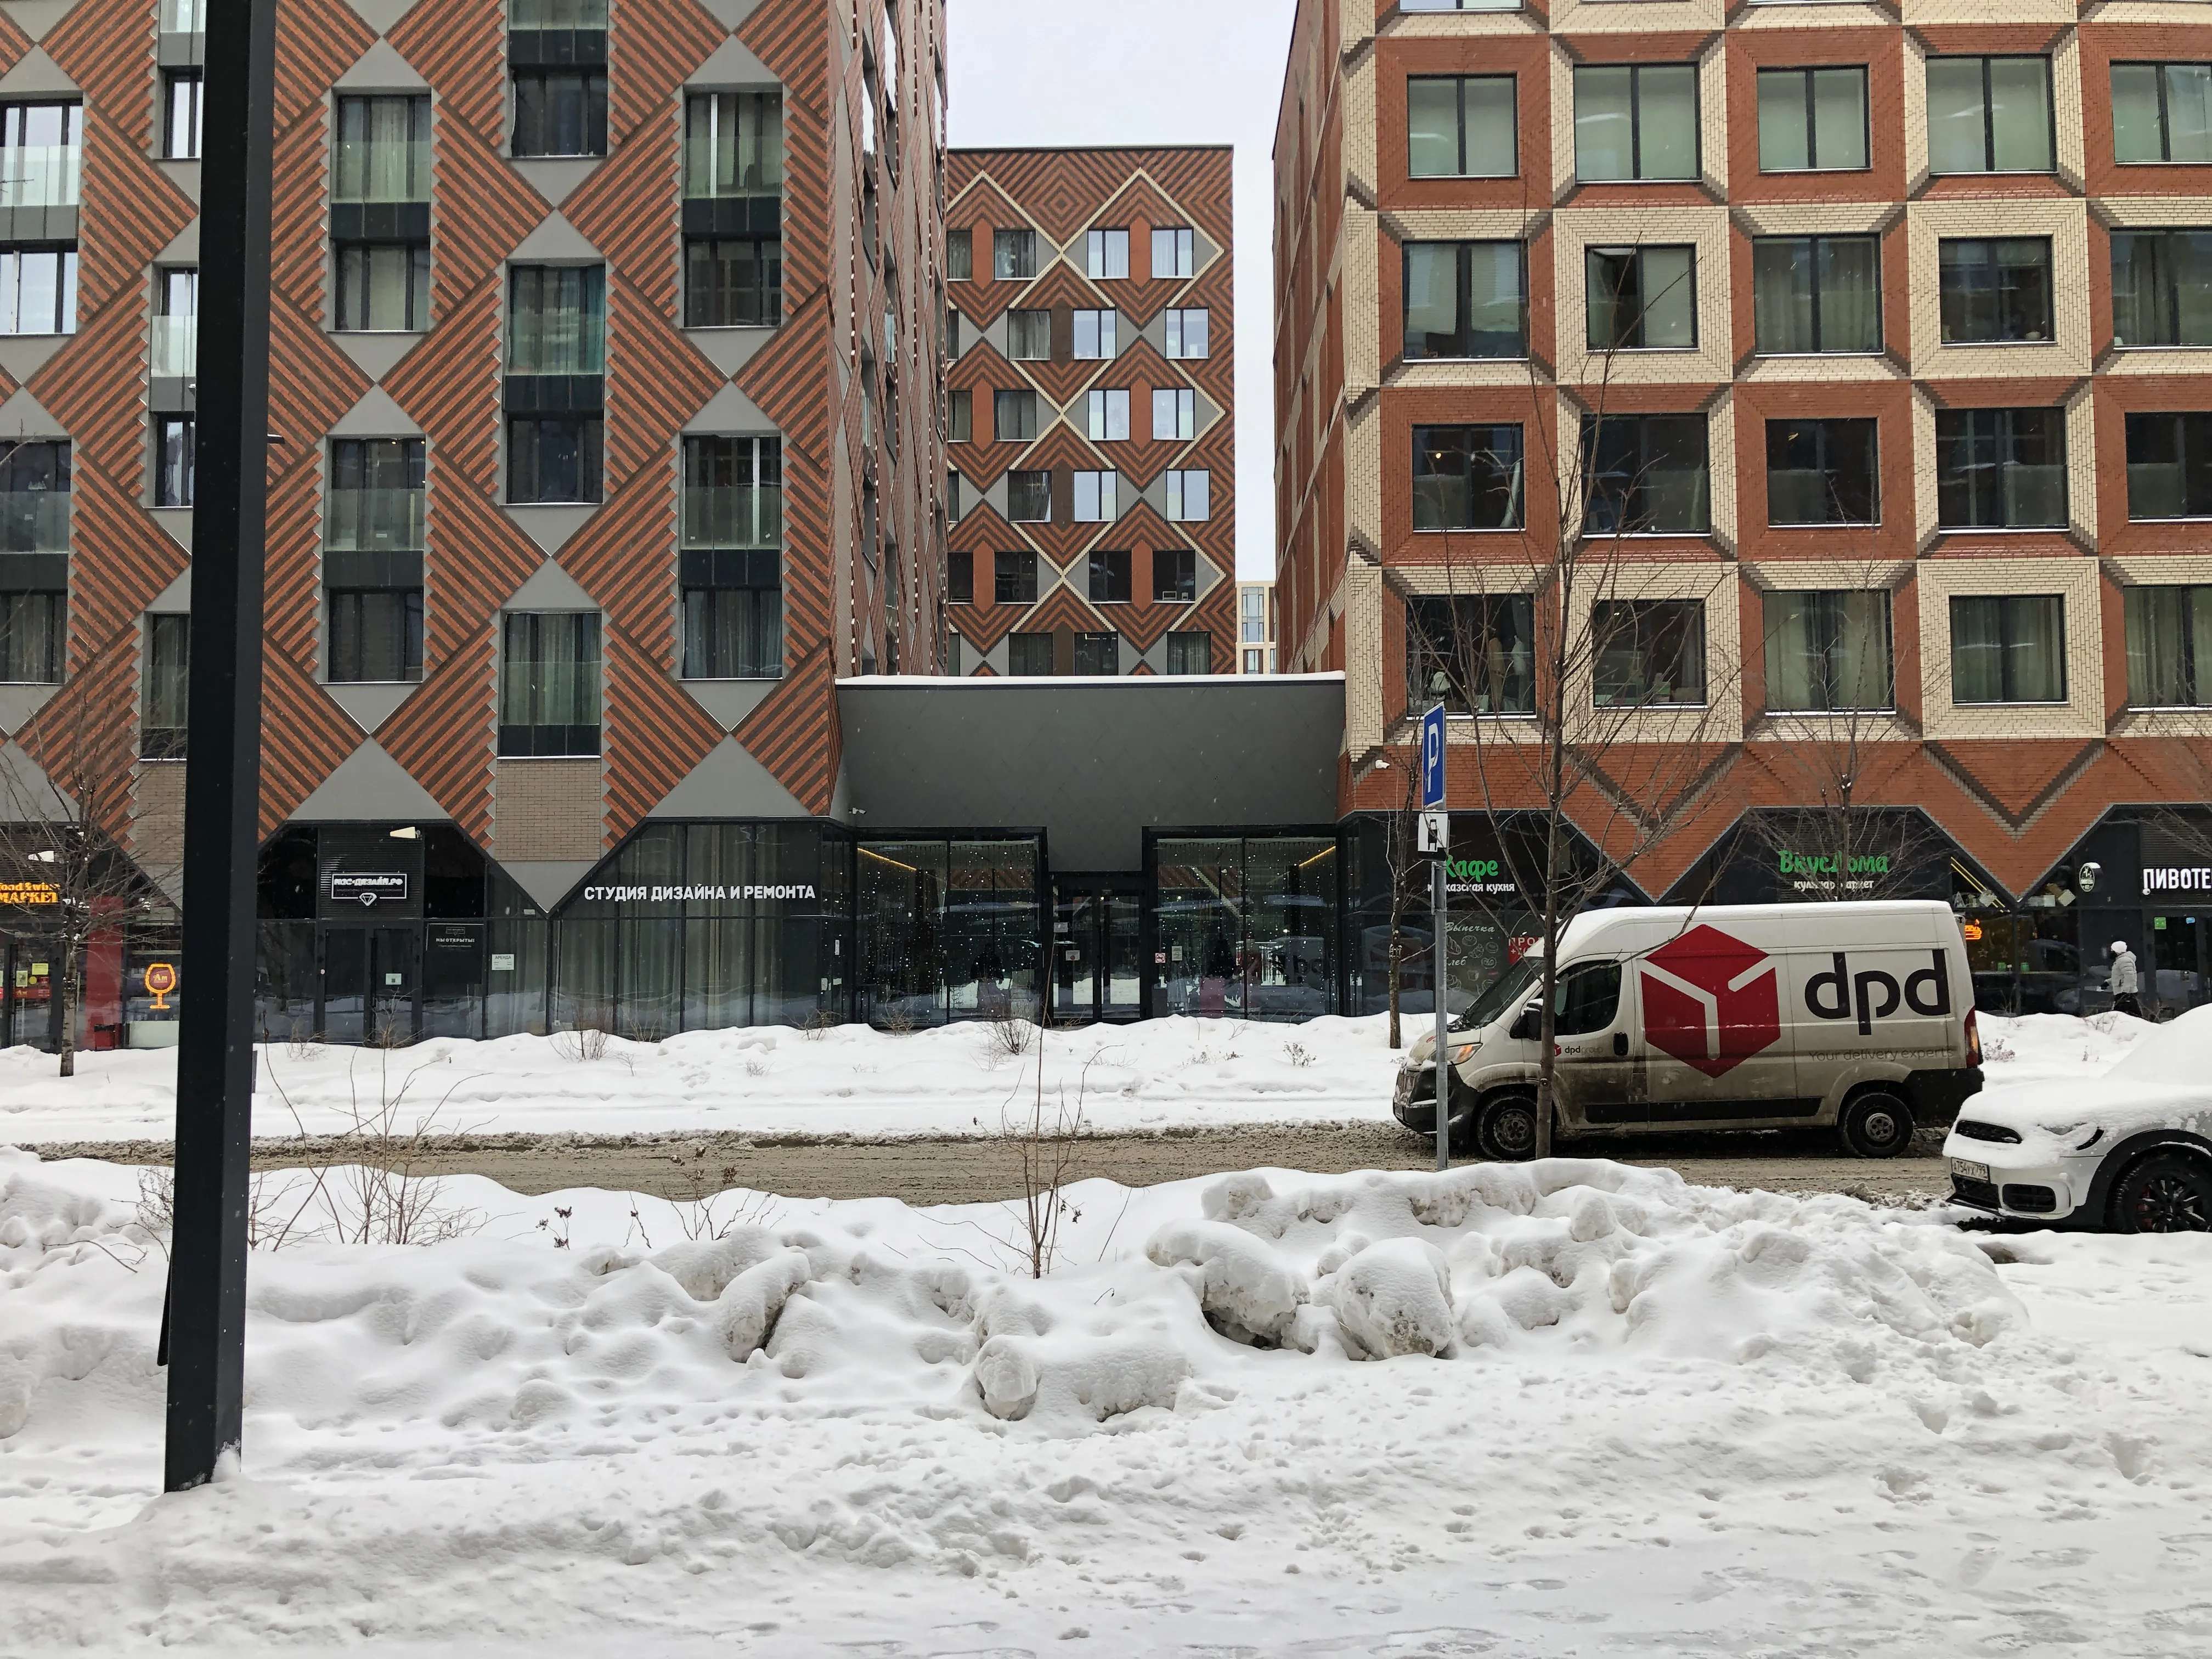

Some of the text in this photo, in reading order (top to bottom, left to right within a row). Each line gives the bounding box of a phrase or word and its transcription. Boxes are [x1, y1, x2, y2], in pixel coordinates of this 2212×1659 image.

[1427, 723, 1439, 793] P
[2143, 868, 2212, 889] ПИВОТЕ
[584, 883, 815, 901] СТУДИЯ ДИЗАЙНА И РЕМОНТА
[1486, 883, 1515, 894] кухня
[1444, 922, 1495, 933] Выпечка
[1508, 937, 1541, 946] ПРО
[1446, 956, 1468, 966] леб
[1804, 949, 1951, 1036] dpd
[1809, 1047, 1954, 1062] Your delivery experts
